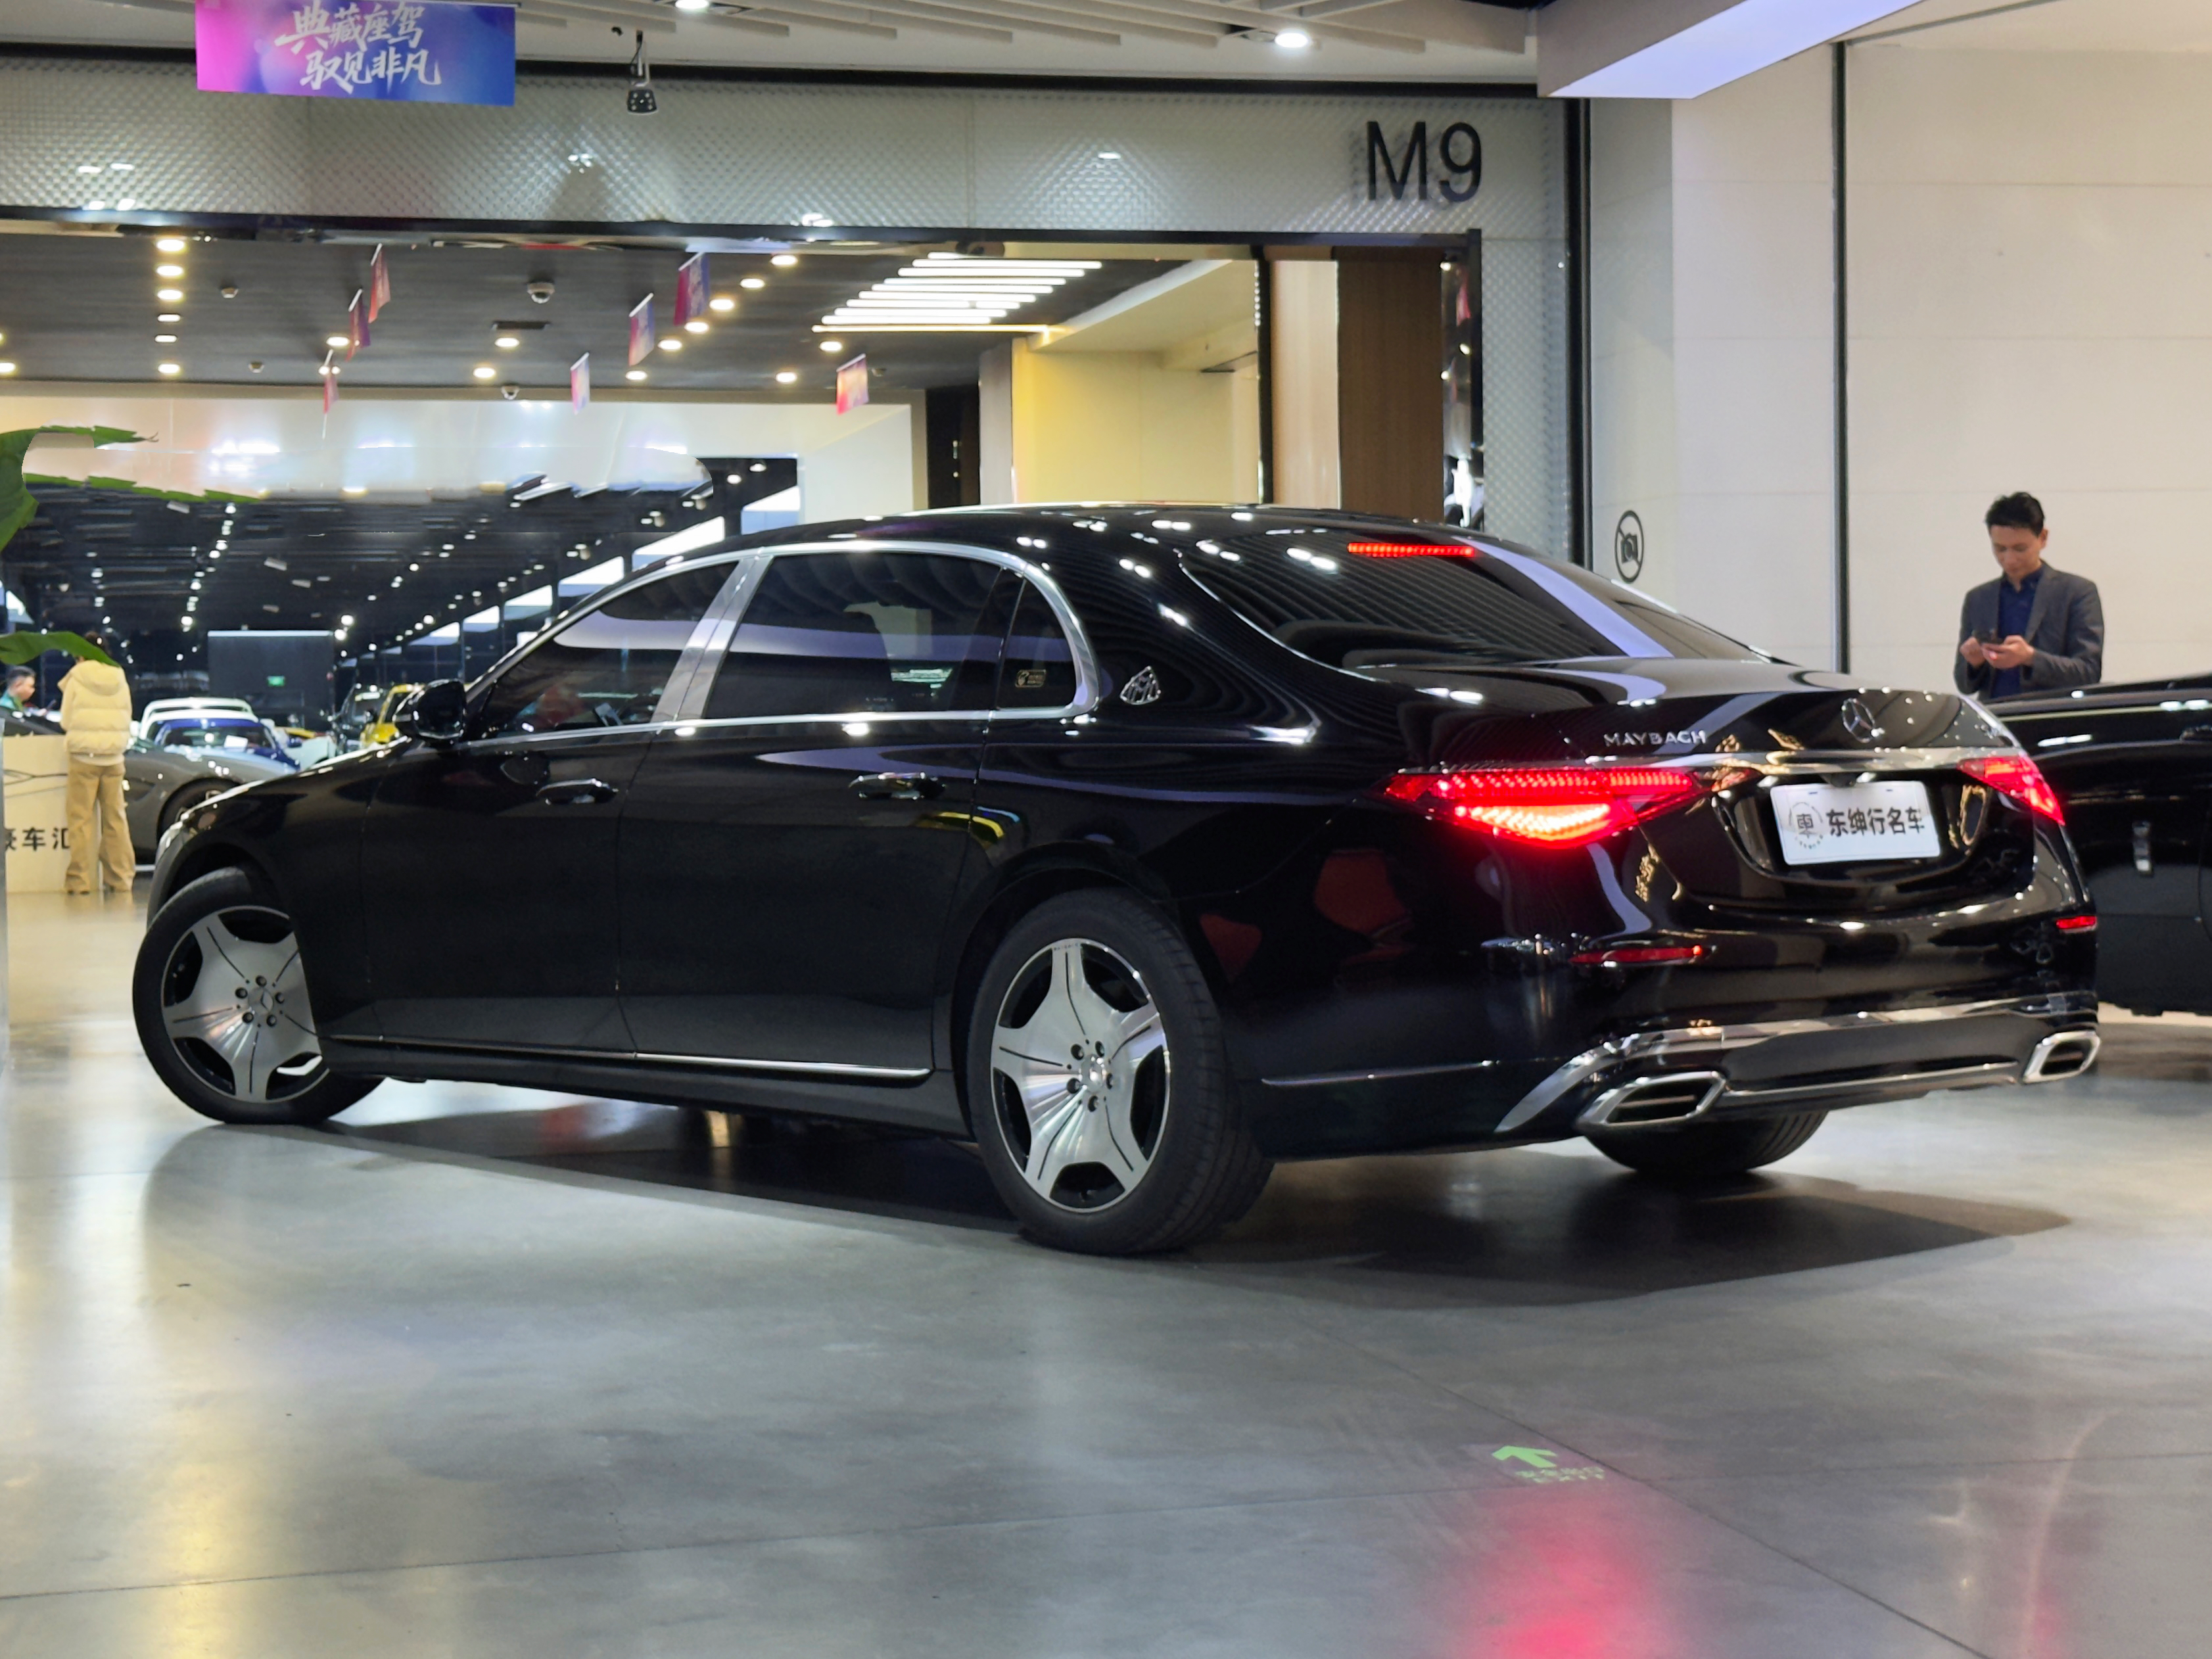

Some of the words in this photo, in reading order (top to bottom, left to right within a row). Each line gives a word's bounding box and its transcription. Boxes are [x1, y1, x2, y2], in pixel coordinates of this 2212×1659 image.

[273, 0, 426, 55] 典藏座驾
[299, 46, 442, 95] 驭见非凡
[1366, 120, 1482, 202] M9
[1603, 730, 1706, 747] MAYBACH
[1825, 806, 1925, 837] 东绅行名车
